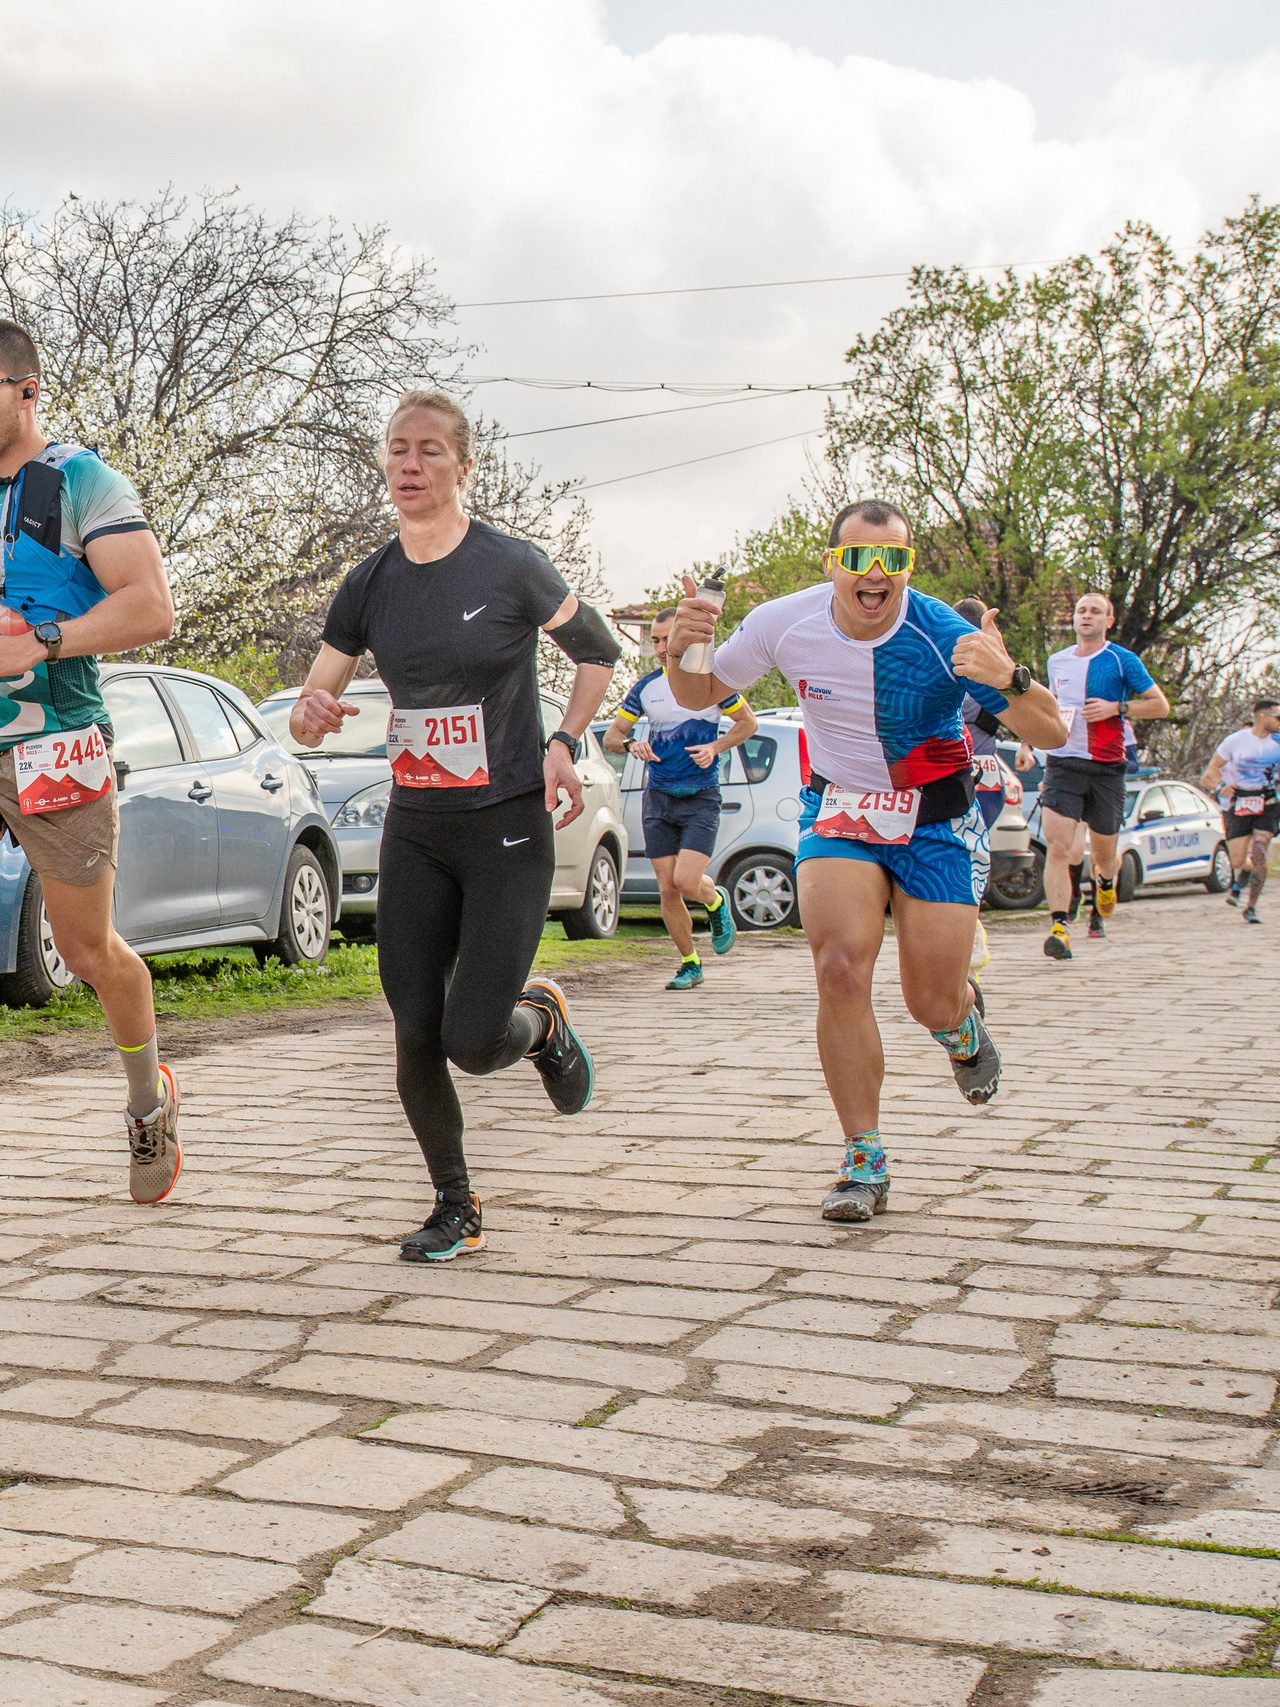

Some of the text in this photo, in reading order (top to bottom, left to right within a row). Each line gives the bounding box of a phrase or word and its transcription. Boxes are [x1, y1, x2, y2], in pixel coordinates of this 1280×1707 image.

[424, 714, 478, 746] 2151
[52, 731, 104, 770] 2445
[19, 761, 33, 771] 22K
[825, 797, 838, 806] 22K
[858, 789, 914, 814] 2199
[1160, 832, 1200, 851] ПОЛИЦИЯ
